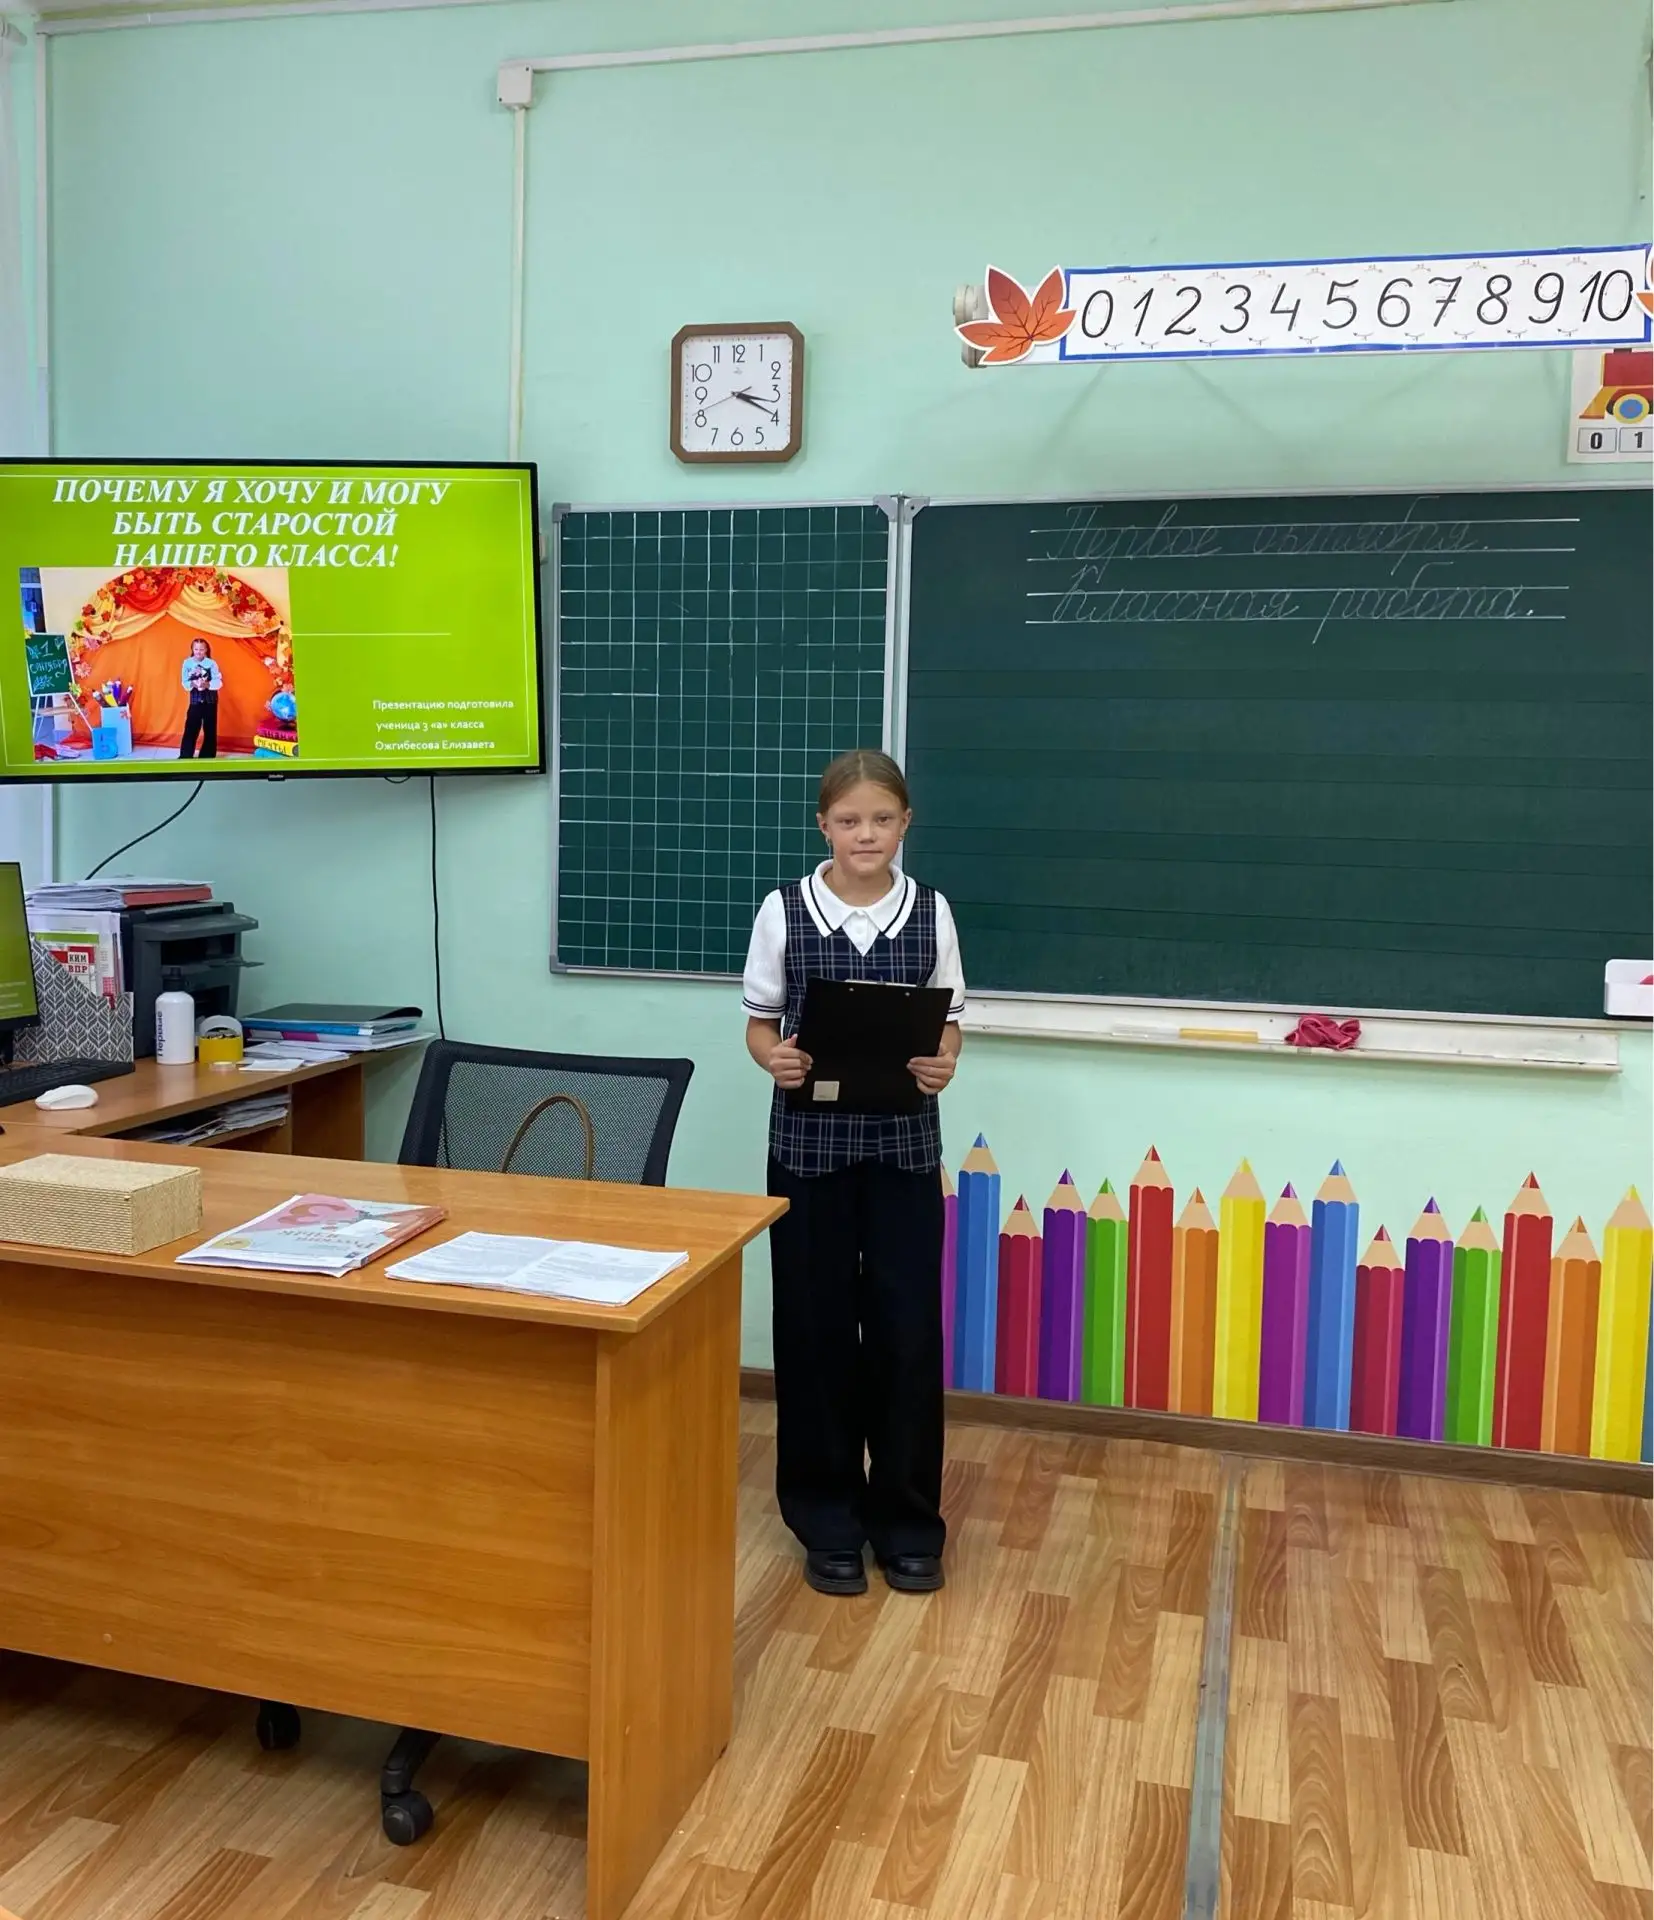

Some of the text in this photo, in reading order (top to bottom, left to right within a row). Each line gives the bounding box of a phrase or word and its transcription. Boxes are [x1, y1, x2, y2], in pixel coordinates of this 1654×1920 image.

[1082, 270, 1633, 338] 0 1 2 3 4 5 6 7 8 9 10
[713, 345, 720, 363] 11
[732, 344, 746, 363] 12
[759, 344, 763, 362] 1
[692, 363, 712, 382] 10
[771, 361, 781, 380] 2
[695, 386, 708, 405] 9
[772, 384, 780, 403] 3
[695, 410, 707, 428] 8
[771, 409, 779, 426] 4
[711, 428, 718, 445] 7
[731, 427, 743, 446] 6
[755, 427, 764, 445] 5
[1590, 432, 1643, 450] 0 1
[52, 479, 452, 505] ПОЧЕМУ Я ХОЧУ И МОГУ
[112, 508, 398, 536] БЫТЬ СТАРОСТОЙ
[1046, 504, 1222, 584] Первое
[113, 544, 398, 568] НАШЕГО КЛАССА!
[1052, 562, 1534, 645] Классная работа.
[372, 700, 514, 712] Презентацию подготовила
[376, 722, 420, 732] ученица
[422, 722, 428, 732] 3
[450, 721, 484, 729] класса
[375, 741, 495, 750] Ожгибесова Елизавета
[69, 954, 86, 962] КИМ
